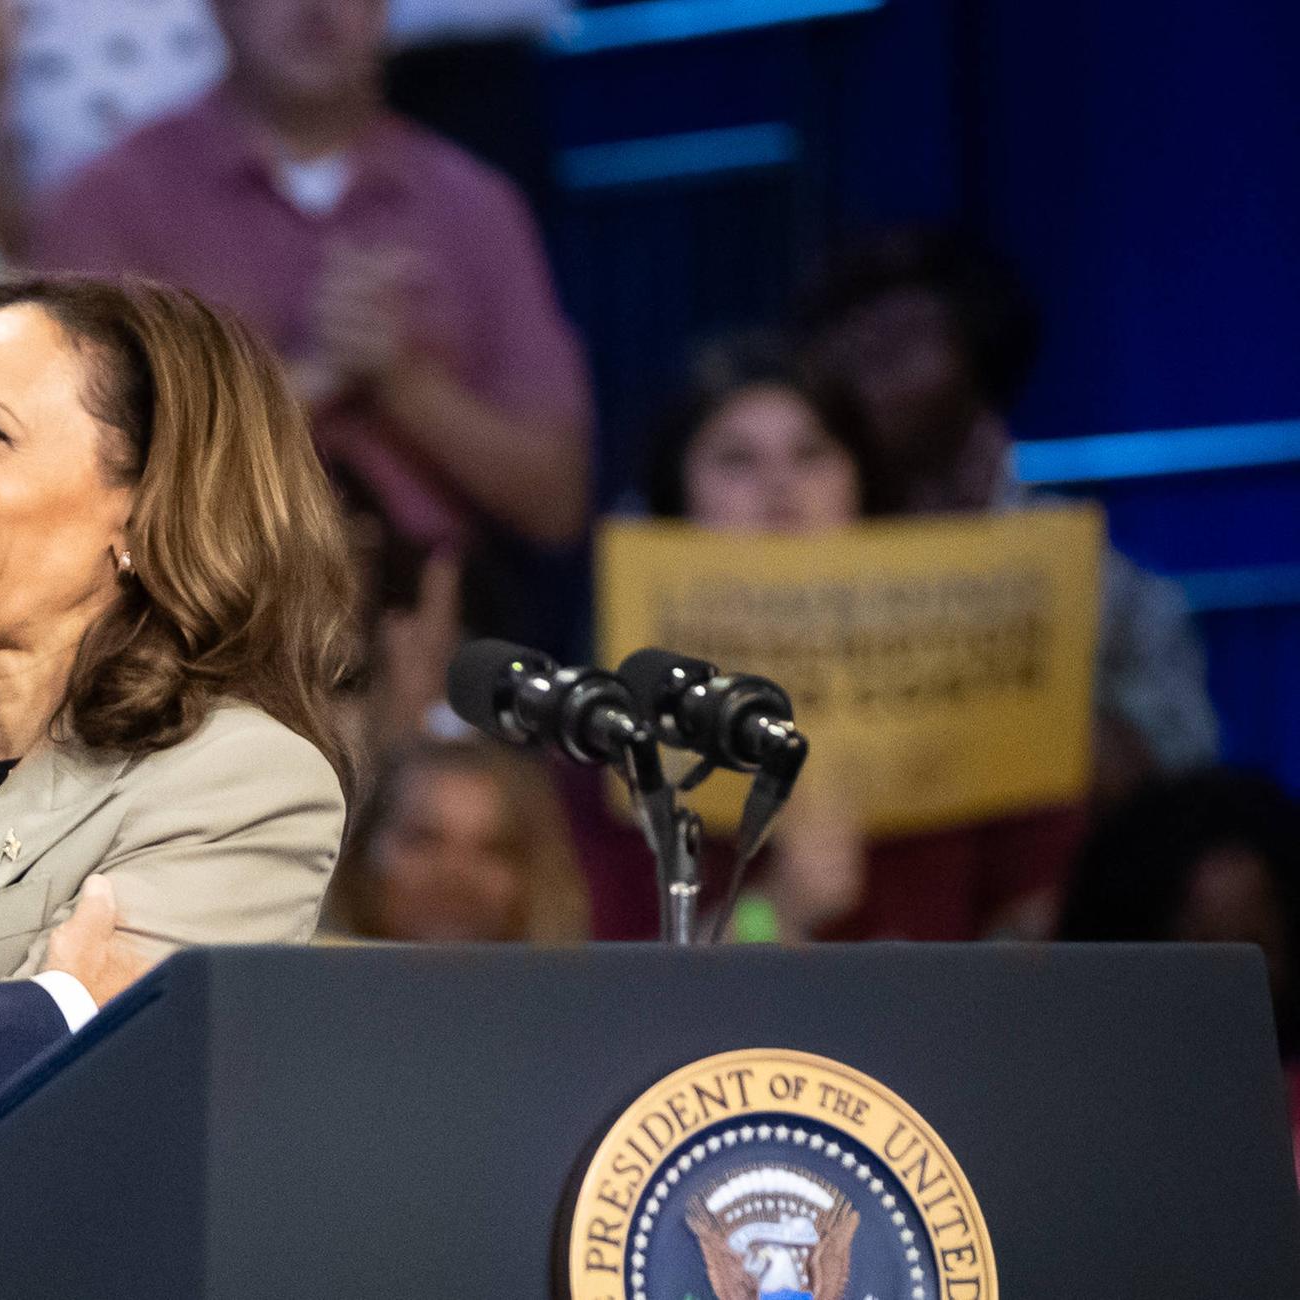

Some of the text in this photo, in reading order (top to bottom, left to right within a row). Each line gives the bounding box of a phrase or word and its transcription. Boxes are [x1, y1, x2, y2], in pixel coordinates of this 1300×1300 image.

[586, 1068, 981, 1300] PRESIDENT OF THE UNITED
